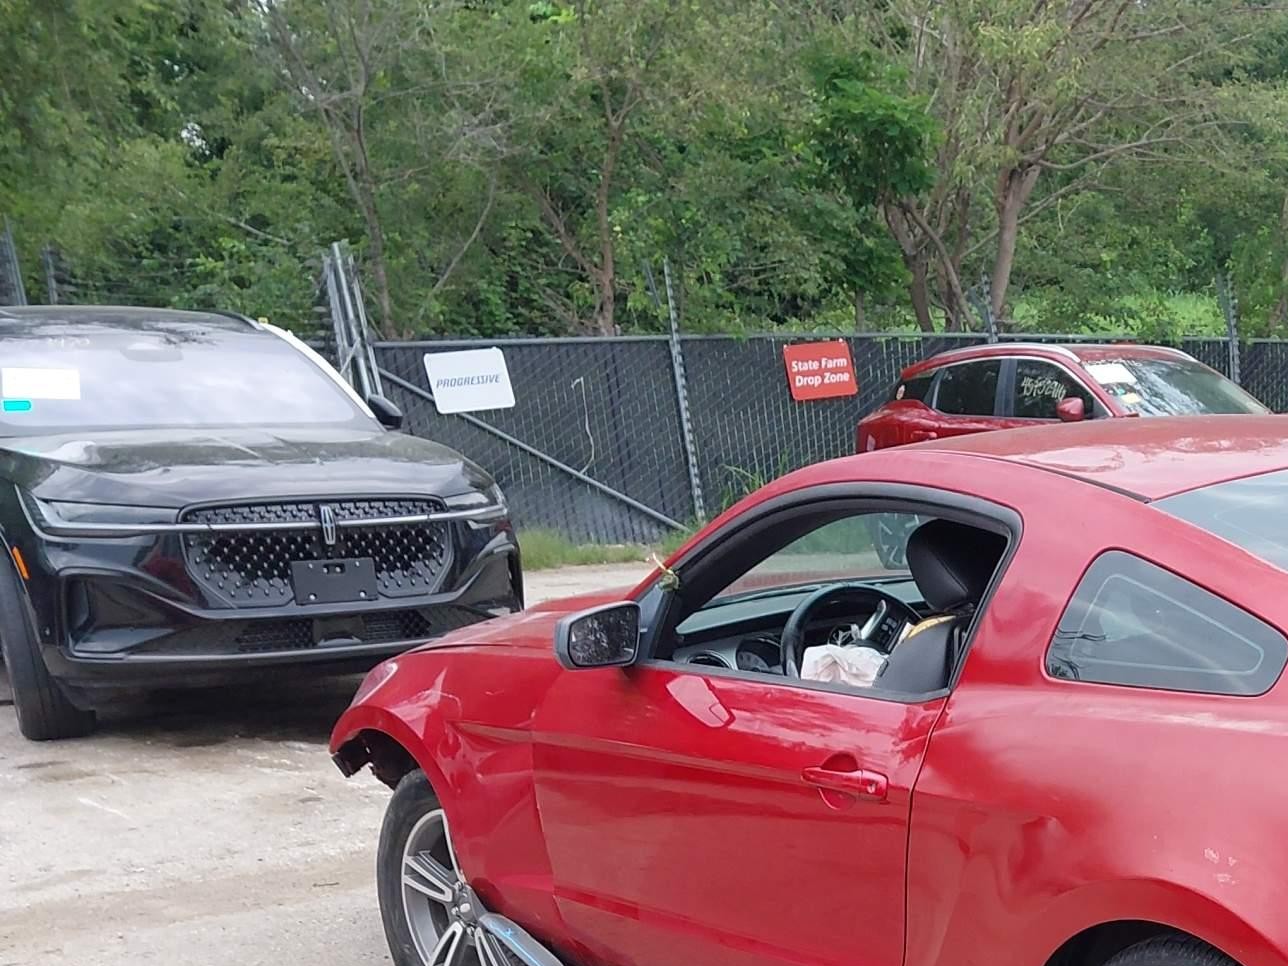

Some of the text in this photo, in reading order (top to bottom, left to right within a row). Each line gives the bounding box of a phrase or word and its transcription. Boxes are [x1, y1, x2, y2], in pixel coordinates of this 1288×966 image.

[791, 358, 848, 372] State Farm
[436, 374, 501, 388] PROGRESSIVE
[795, 372, 850, 388] Drop Zone
